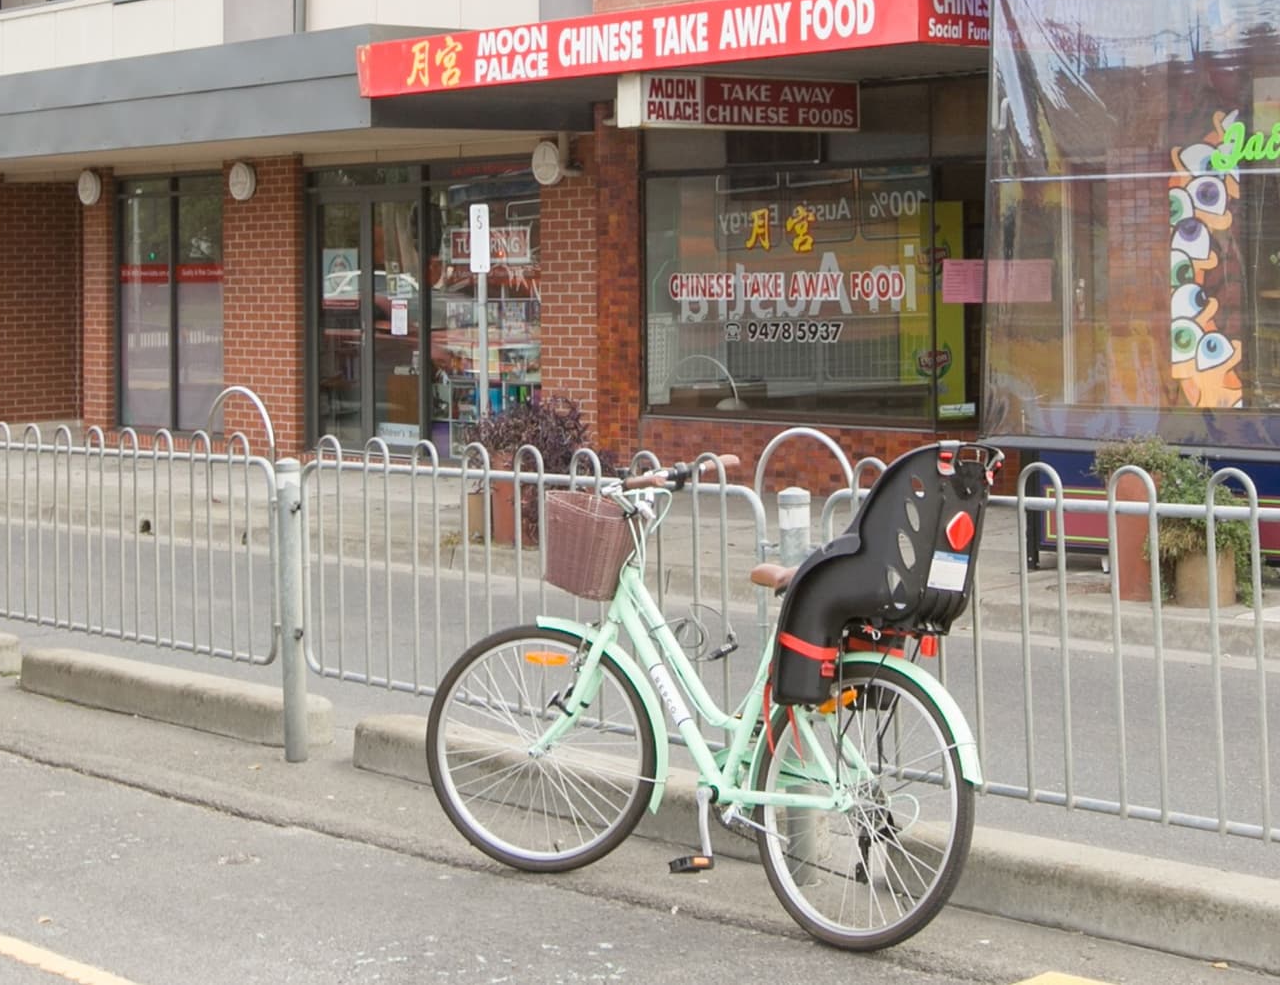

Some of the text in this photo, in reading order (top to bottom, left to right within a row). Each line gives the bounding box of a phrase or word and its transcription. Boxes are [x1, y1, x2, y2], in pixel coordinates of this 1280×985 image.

[558, 21, 643, 68] CHINESE
[653, 12, 709, 57] TAKE
[720, 1, 792, 50] AWAY
[928, 18, 963, 39] Social
[477, 25, 548, 56] MOON
[475, 51, 549, 83] PALACE
[649, 77, 697, 100] MOON
[720, 83, 835, 104] TAKE AWAY
[647, 100, 699, 122] PALACE
[706, 105, 854, 126] CHINESE FOODS
[455, 236, 521, 255] TURING
[670, 270, 906, 301] CHINESE TAKE AWAY FOOD
[747, 321, 843, 343] 9478 5937
